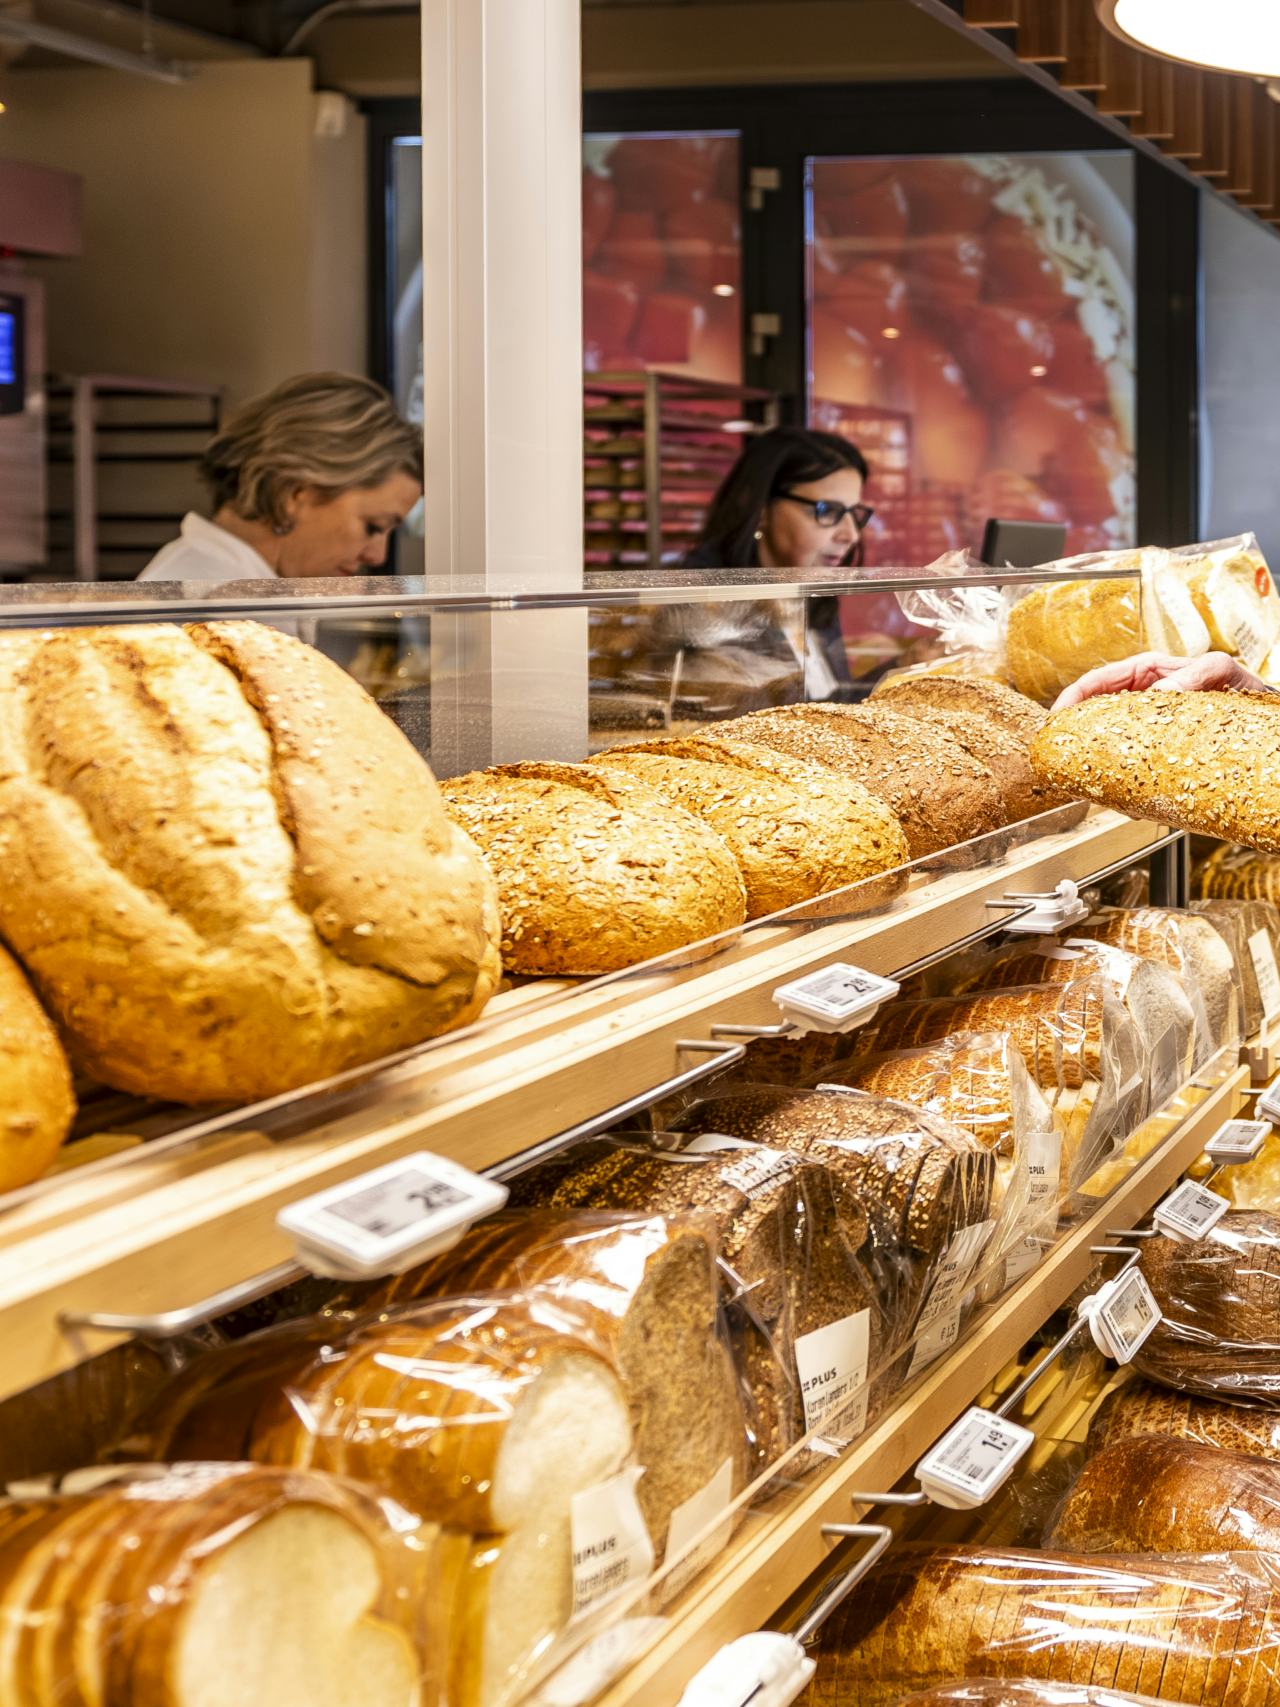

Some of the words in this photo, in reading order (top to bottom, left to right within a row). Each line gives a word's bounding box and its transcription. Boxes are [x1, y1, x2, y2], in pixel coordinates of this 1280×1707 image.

[1033, 1166, 1045, 1175] PLUS
[811, 1367, 838, 1389] PLUS
[981, 1429, 1008, 1452] 1.49
[583, 1536, 617, 1561] PLUS
